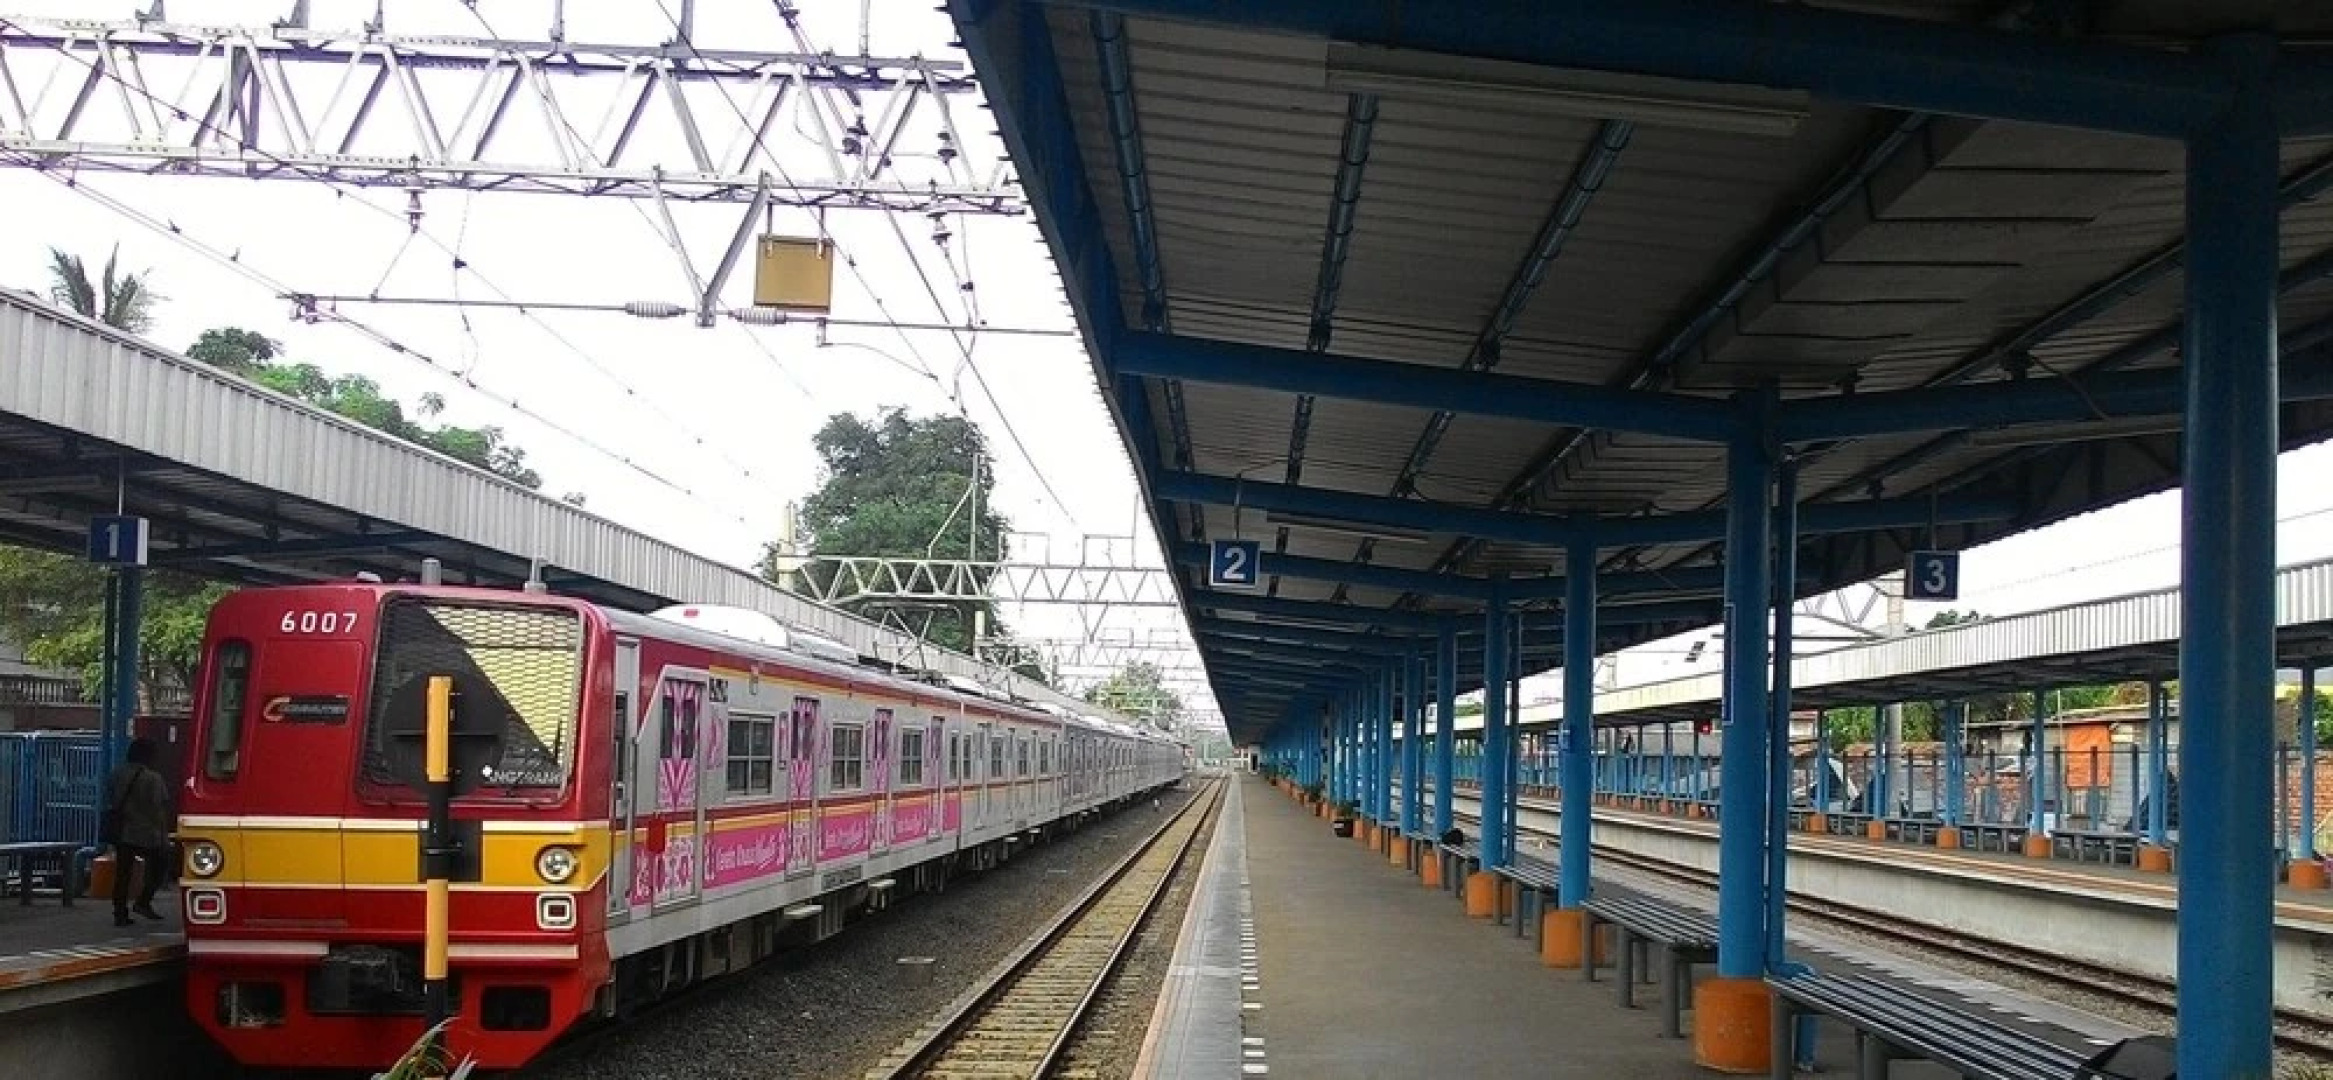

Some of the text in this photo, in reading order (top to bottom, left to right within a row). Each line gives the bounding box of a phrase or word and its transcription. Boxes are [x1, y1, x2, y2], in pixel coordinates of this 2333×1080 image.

[105, 524, 119, 557] 1
[1222, 547, 1247, 579] 2
[1924, 560, 1947, 592] 3
[281, 610, 358, 633] 6007
